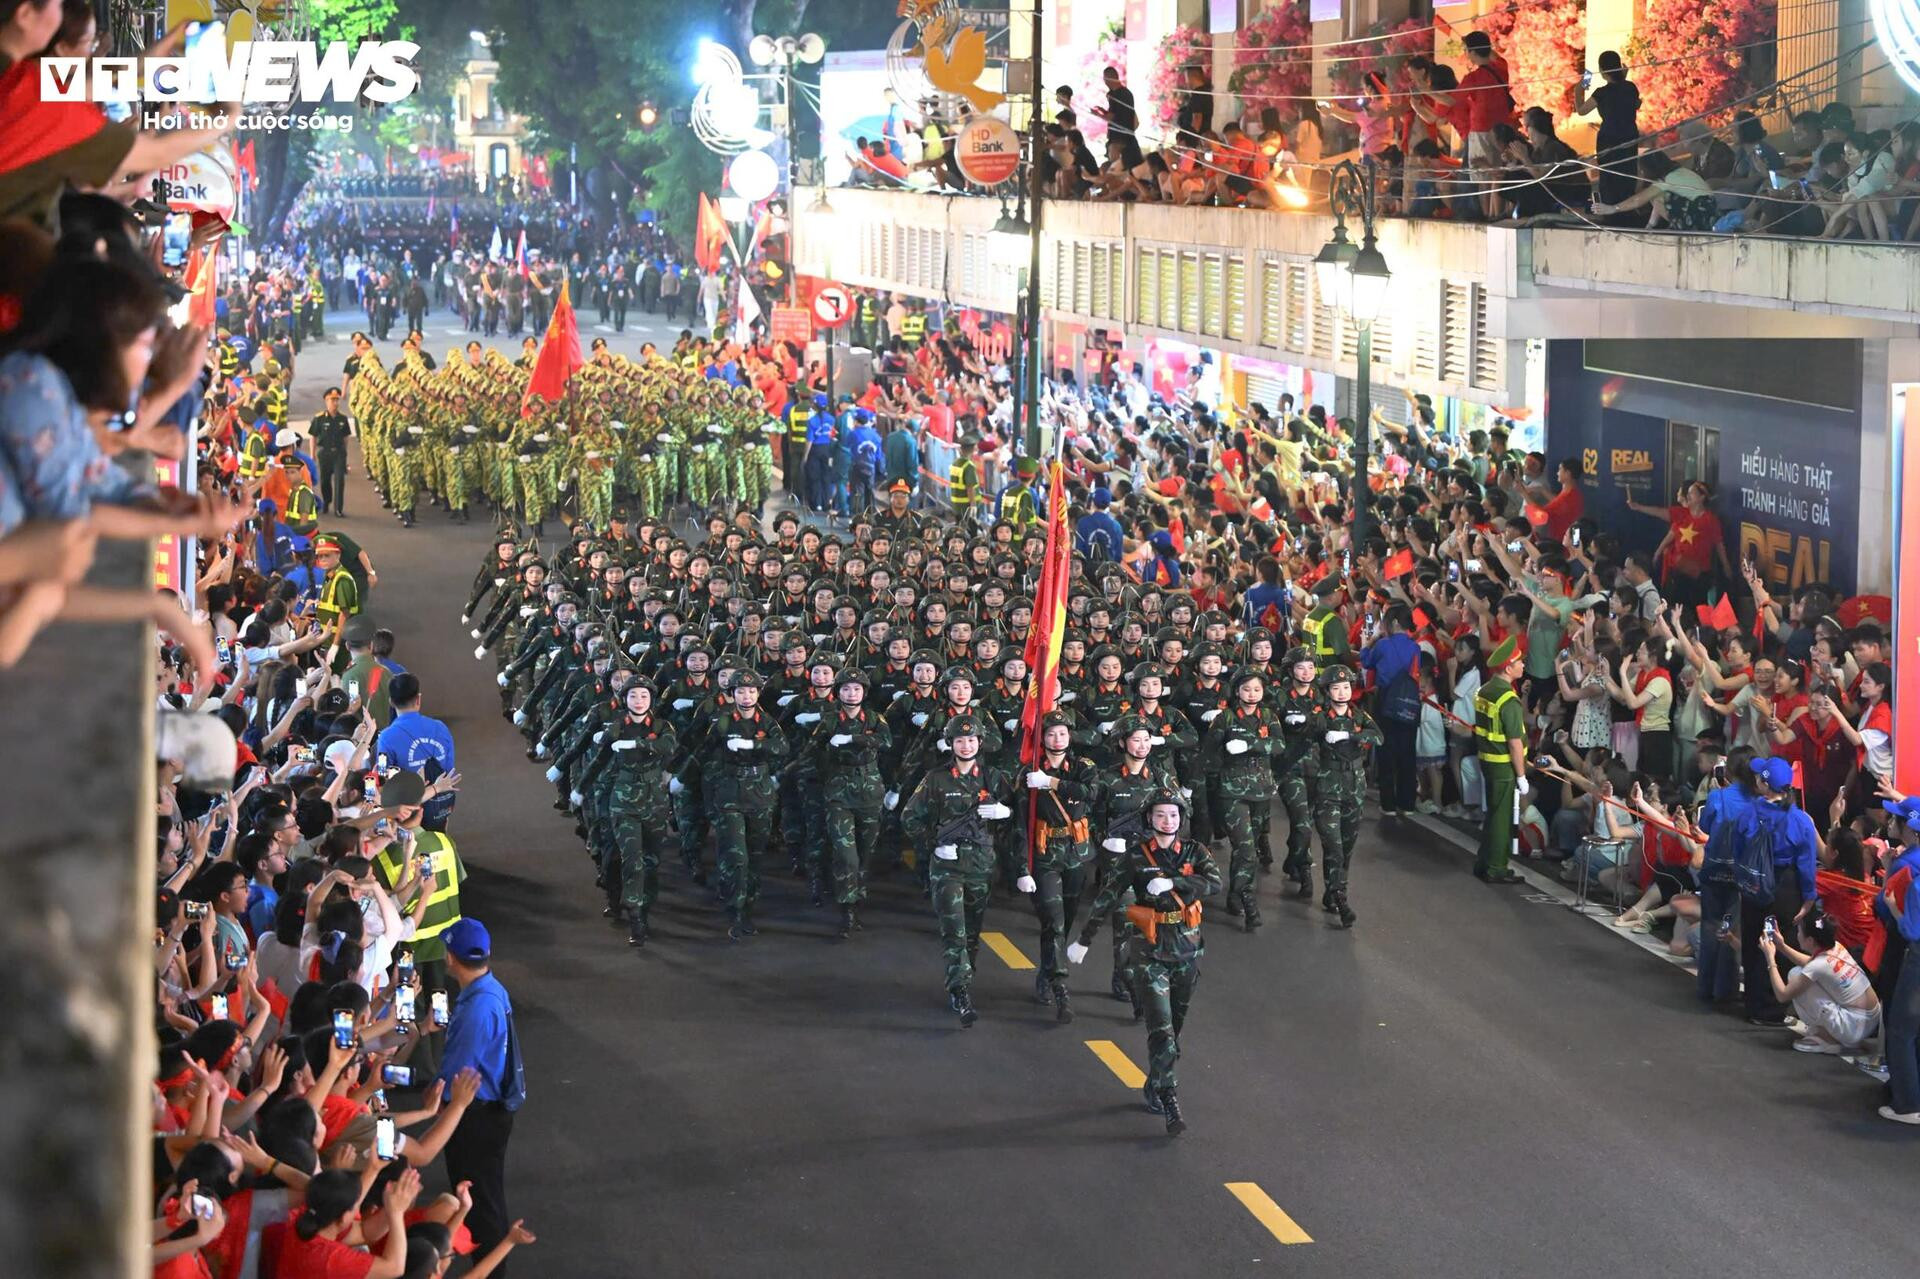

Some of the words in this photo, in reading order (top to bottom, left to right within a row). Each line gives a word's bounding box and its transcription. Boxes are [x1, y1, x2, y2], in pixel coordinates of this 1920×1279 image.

[972, 129, 990, 141] HD
[972, 141, 1004, 153] Bank
[160, 165, 188, 181] HD
[1583, 448, 1598, 475] 62
[1611, 449, 1653, 473] REAL
[1741, 446, 1767, 477] HIỂU
[1770, 454, 1799, 484] HÀNG
[1804, 462, 1833, 495] THẬT
[1741, 483, 1776, 514] TRÁNH
[1778, 491, 1808, 522] HÀNG
[1811, 497, 1831, 527] GIẢ
